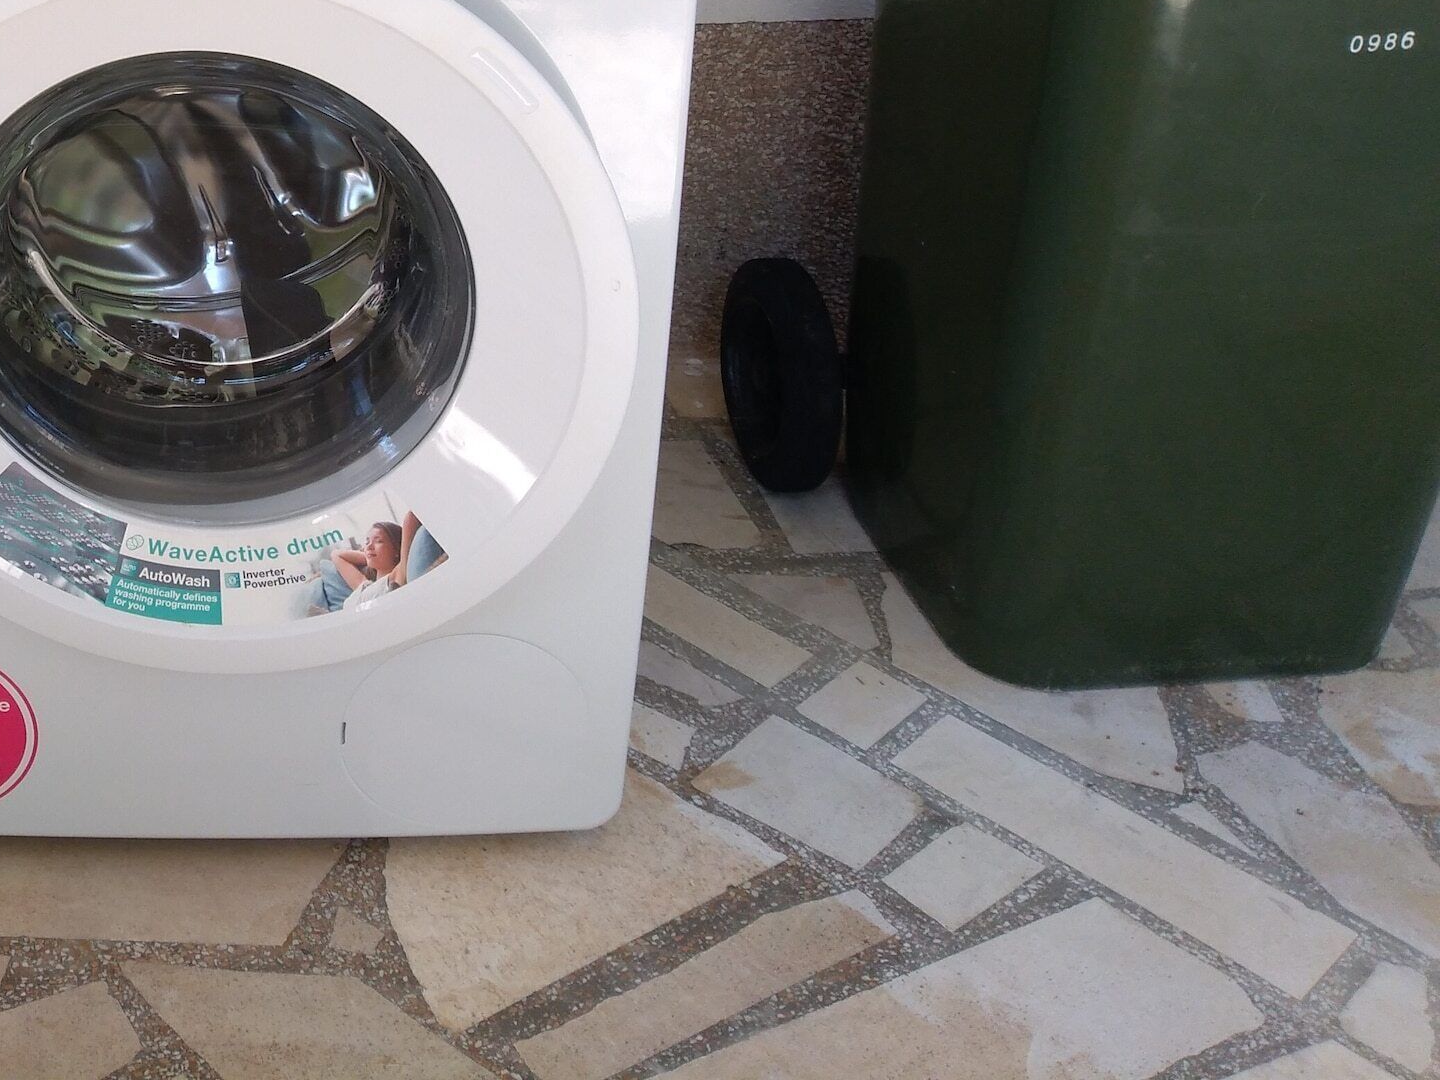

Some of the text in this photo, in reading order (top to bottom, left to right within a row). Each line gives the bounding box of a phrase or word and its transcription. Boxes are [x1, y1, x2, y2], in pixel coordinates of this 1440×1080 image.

[1349, 31, 1416, 54] 0986
[147, 526, 344, 564] WaveActive drum
[139, 566, 211, 589] AutoWash
[242, 567, 285, 580] Inverter
[244, 572, 306, 589] PowerDrive
[114, 588, 211, 613] washing programme
[116, 578, 218, 604] Automatically defines
[112, 597, 146, 613] for you
